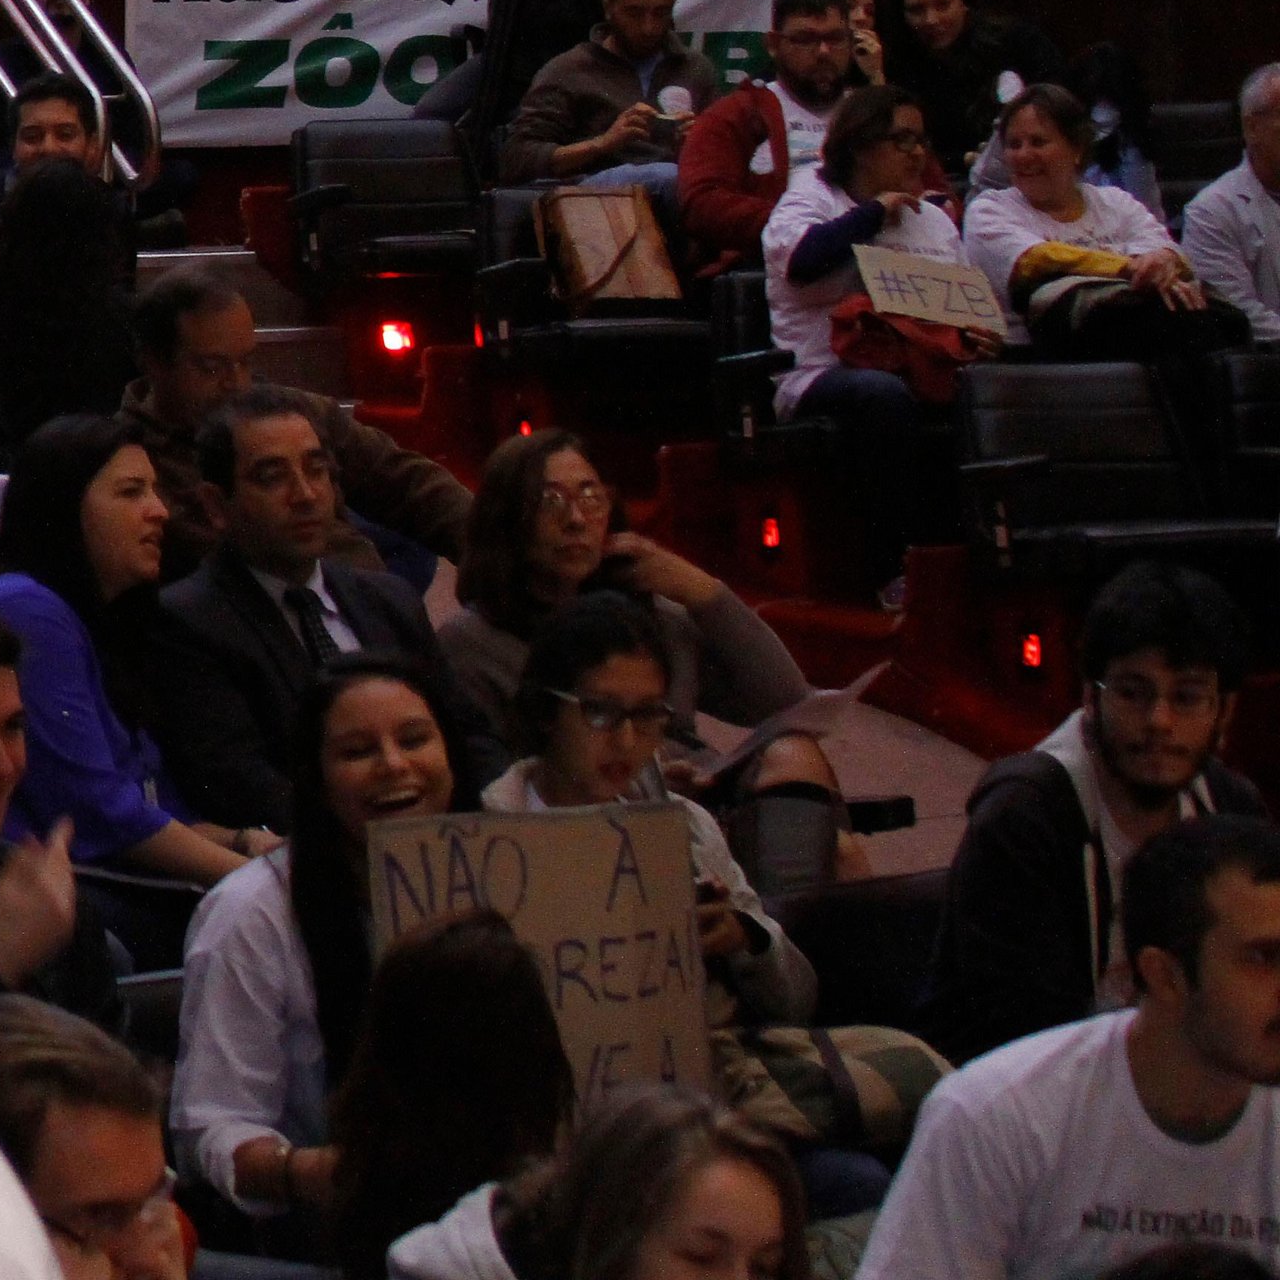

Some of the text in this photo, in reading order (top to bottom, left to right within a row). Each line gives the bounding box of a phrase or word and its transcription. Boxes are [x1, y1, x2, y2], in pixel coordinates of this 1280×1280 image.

[874, 269, 997, 318] #FZB
[384, 817, 649, 939] NÃO À
